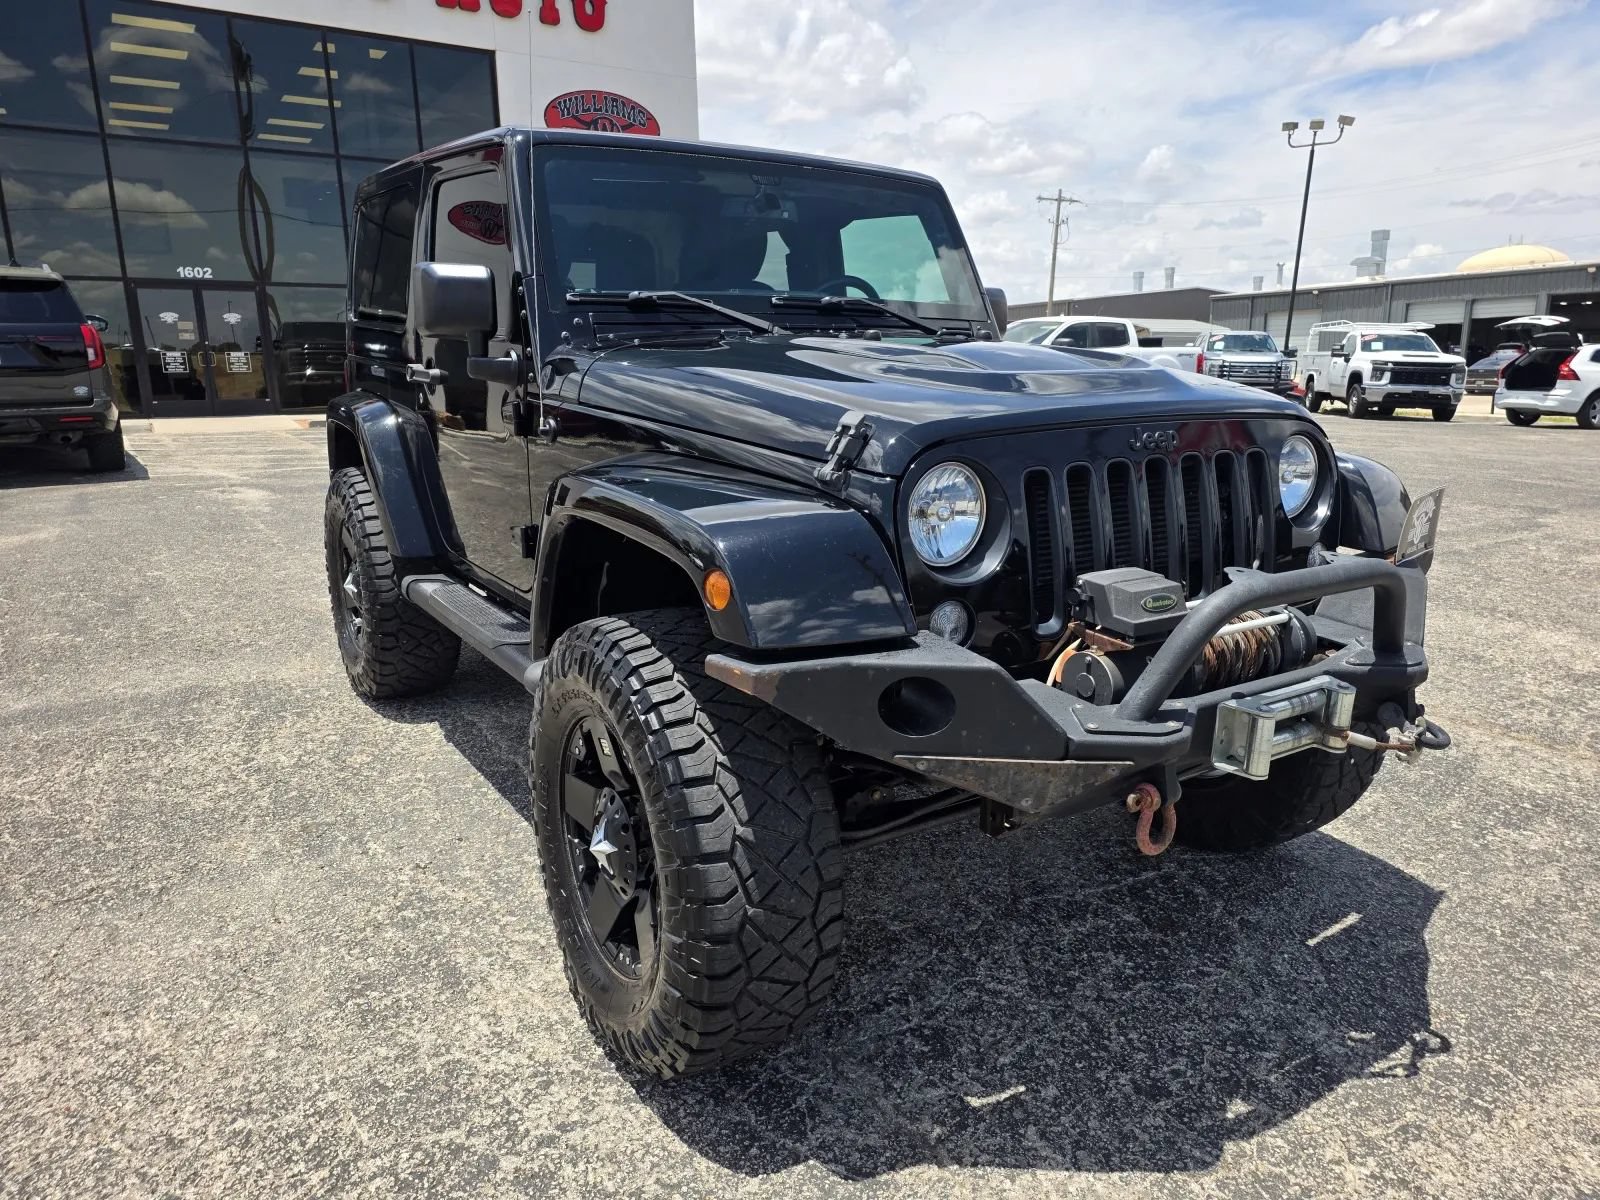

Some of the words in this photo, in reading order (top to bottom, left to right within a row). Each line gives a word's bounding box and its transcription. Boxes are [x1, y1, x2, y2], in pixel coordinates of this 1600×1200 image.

[556, 94, 648, 129] WILLIAMS
[176, 266, 213, 279] 1602
[1128, 427, 1180, 451] Jeep
